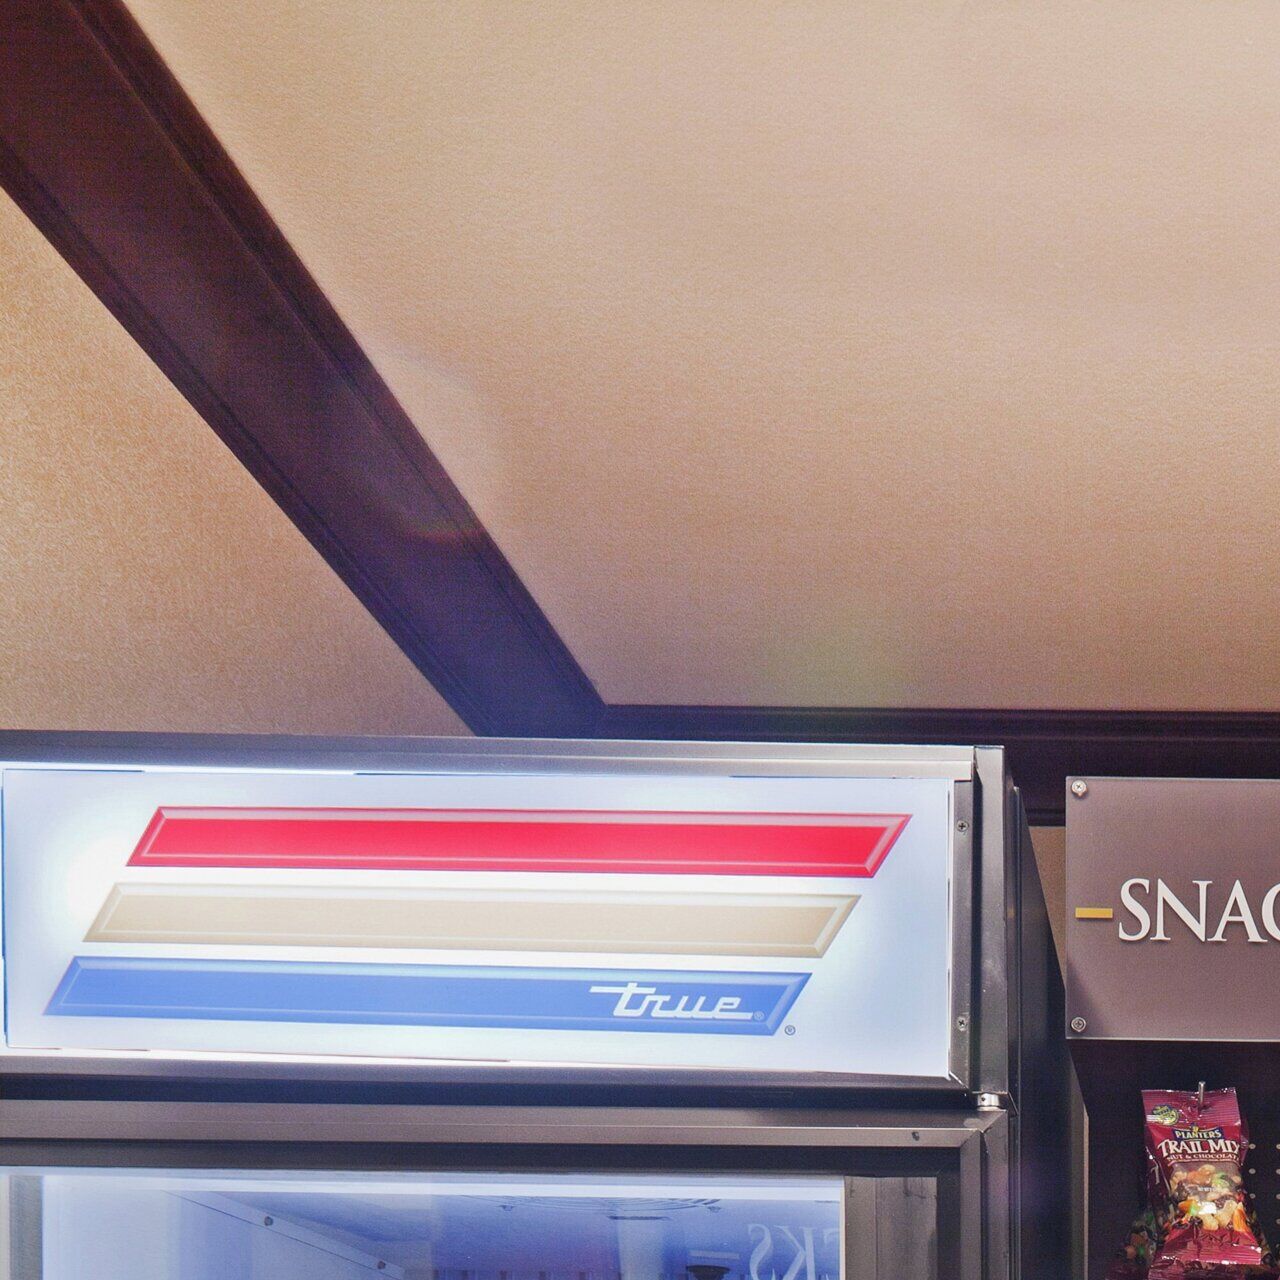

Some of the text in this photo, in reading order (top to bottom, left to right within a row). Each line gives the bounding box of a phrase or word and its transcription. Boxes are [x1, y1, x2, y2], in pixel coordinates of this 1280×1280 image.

[589, 982, 755, 1020] true
[1175, 1129, 1222, 1139] PLANTERS
[1157, 1139, 1240, 1157] TRAIL MIX
